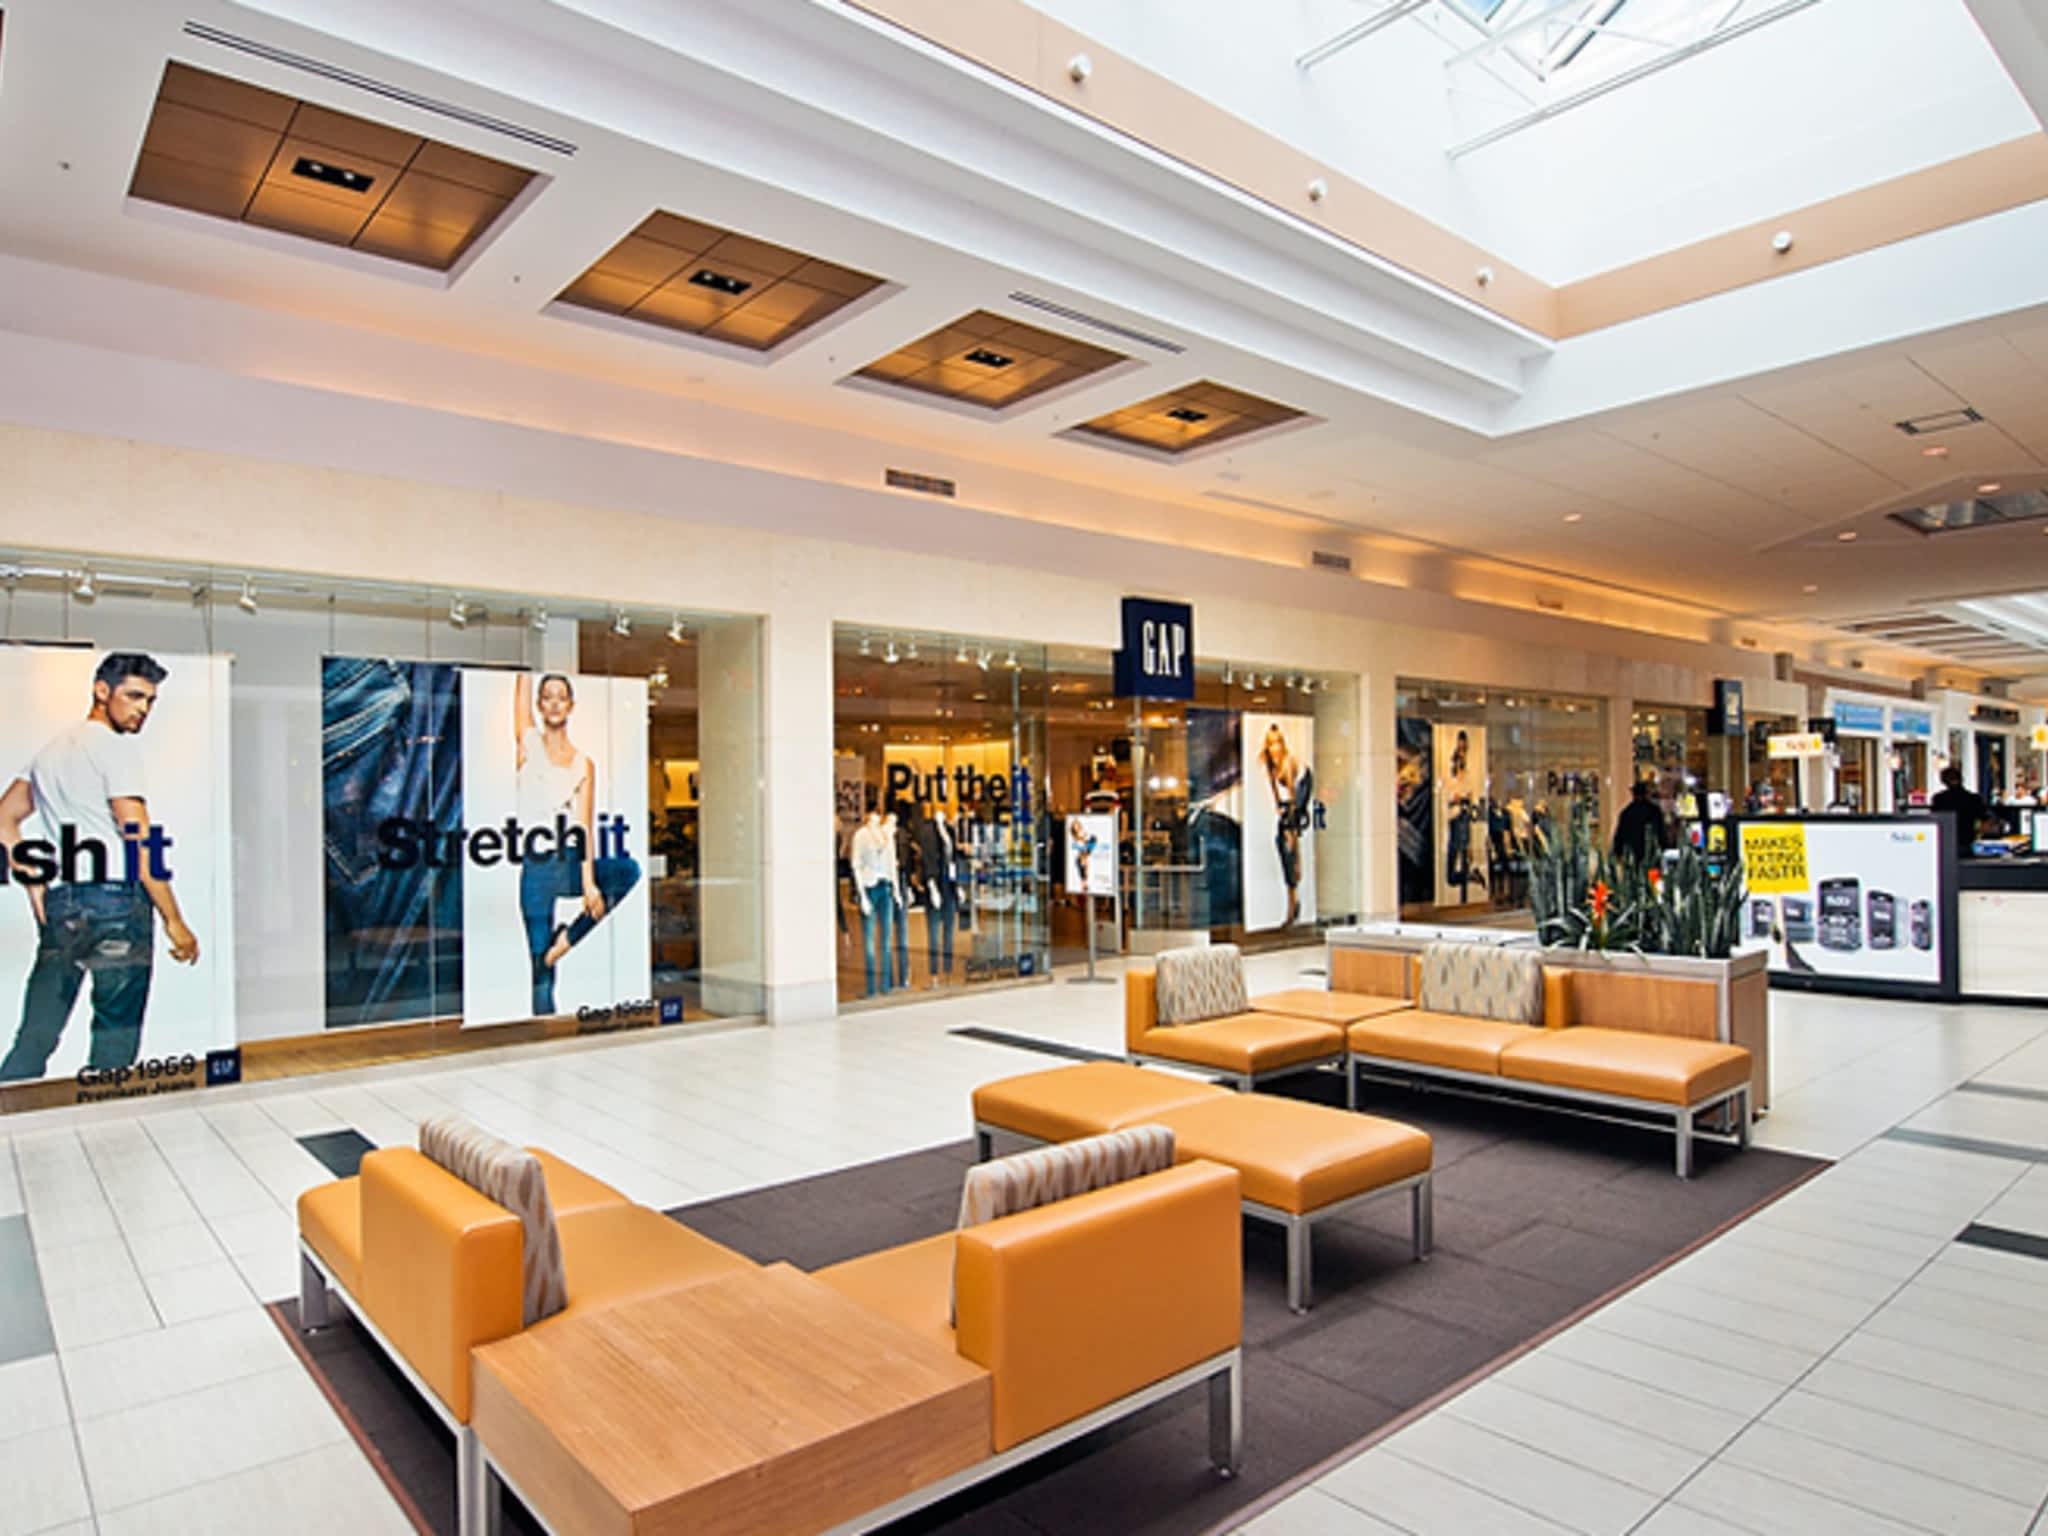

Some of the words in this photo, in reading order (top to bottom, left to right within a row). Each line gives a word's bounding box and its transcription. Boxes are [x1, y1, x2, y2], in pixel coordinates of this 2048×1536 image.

[1142, 620, 1186, 677] GAP
[886, 763, 948, 802] Put
[952, 763, 1006, 801] the
[0, 822, 108, 885] sh
[124, 822, 173, 882] it
[377, 813, 587, 870] Stretch
[597, 813, 630, 859] it
[77, 1064, 131, 1088] Gap
[134, 1053, 197, 1080] 1969
